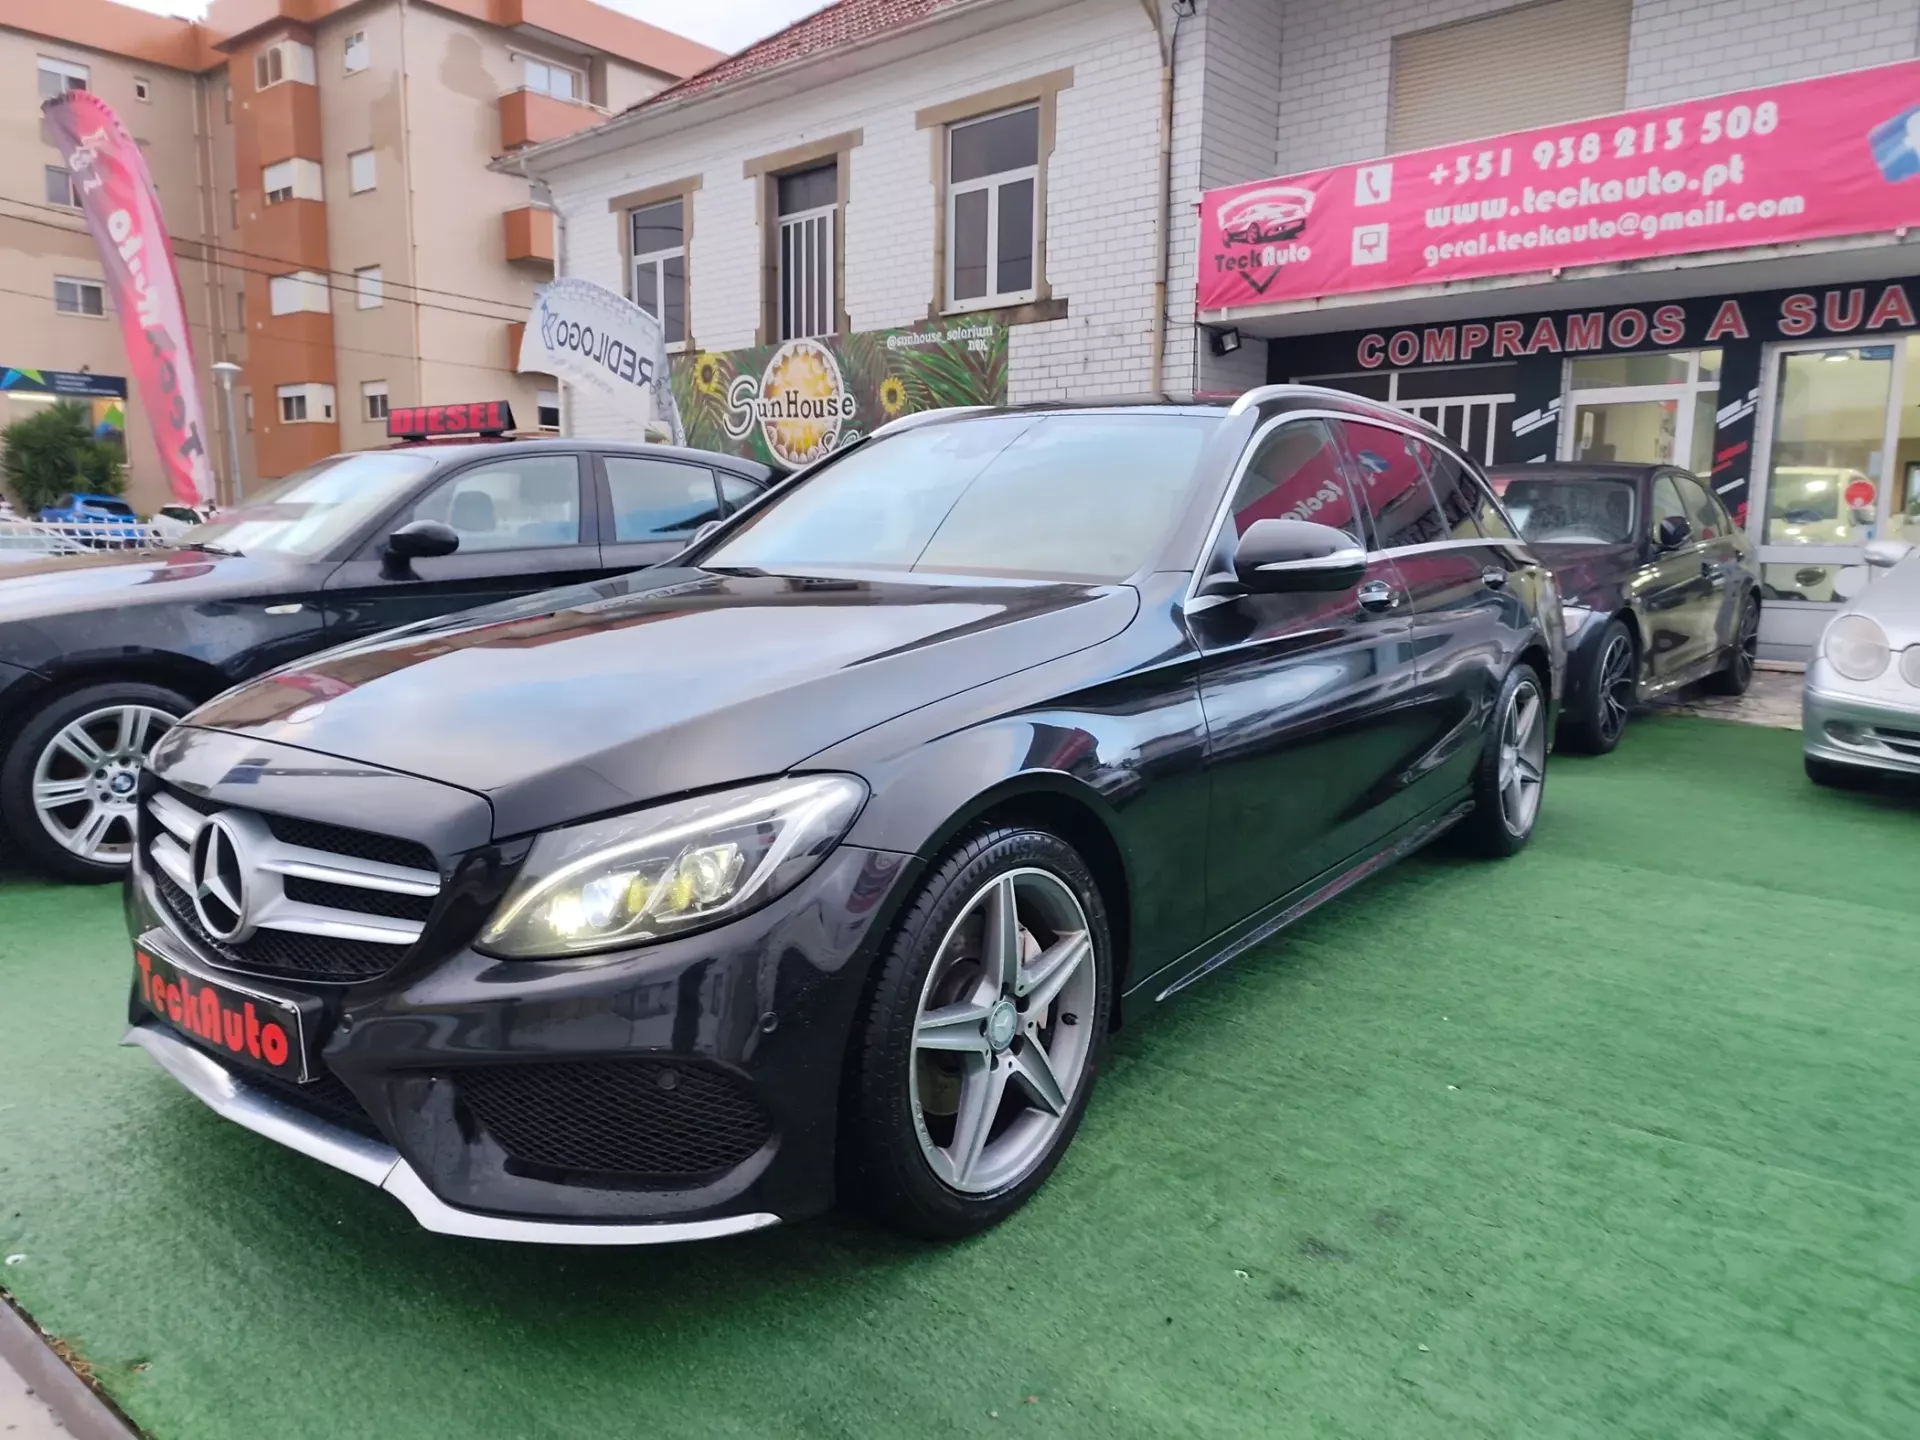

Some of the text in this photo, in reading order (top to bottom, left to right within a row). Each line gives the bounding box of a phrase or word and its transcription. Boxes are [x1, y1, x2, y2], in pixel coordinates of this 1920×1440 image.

[1428, 100, 1779, 185] +351 938 213 508
[1425, 154, 1745, 228] www.teckauto.pt
[1214, 243, 1312, 272] TeckAuto
[1423, 195, 1805, 267] geral.teckauto@gmail.com
[1356, 285, 1917, 368] COMPRAMOS A SUA
[390, 402, 504, 434] DIESEL
[722, 375, 855, 439] SunHouse
[137, 952, 288, 1067] TeckAuto
